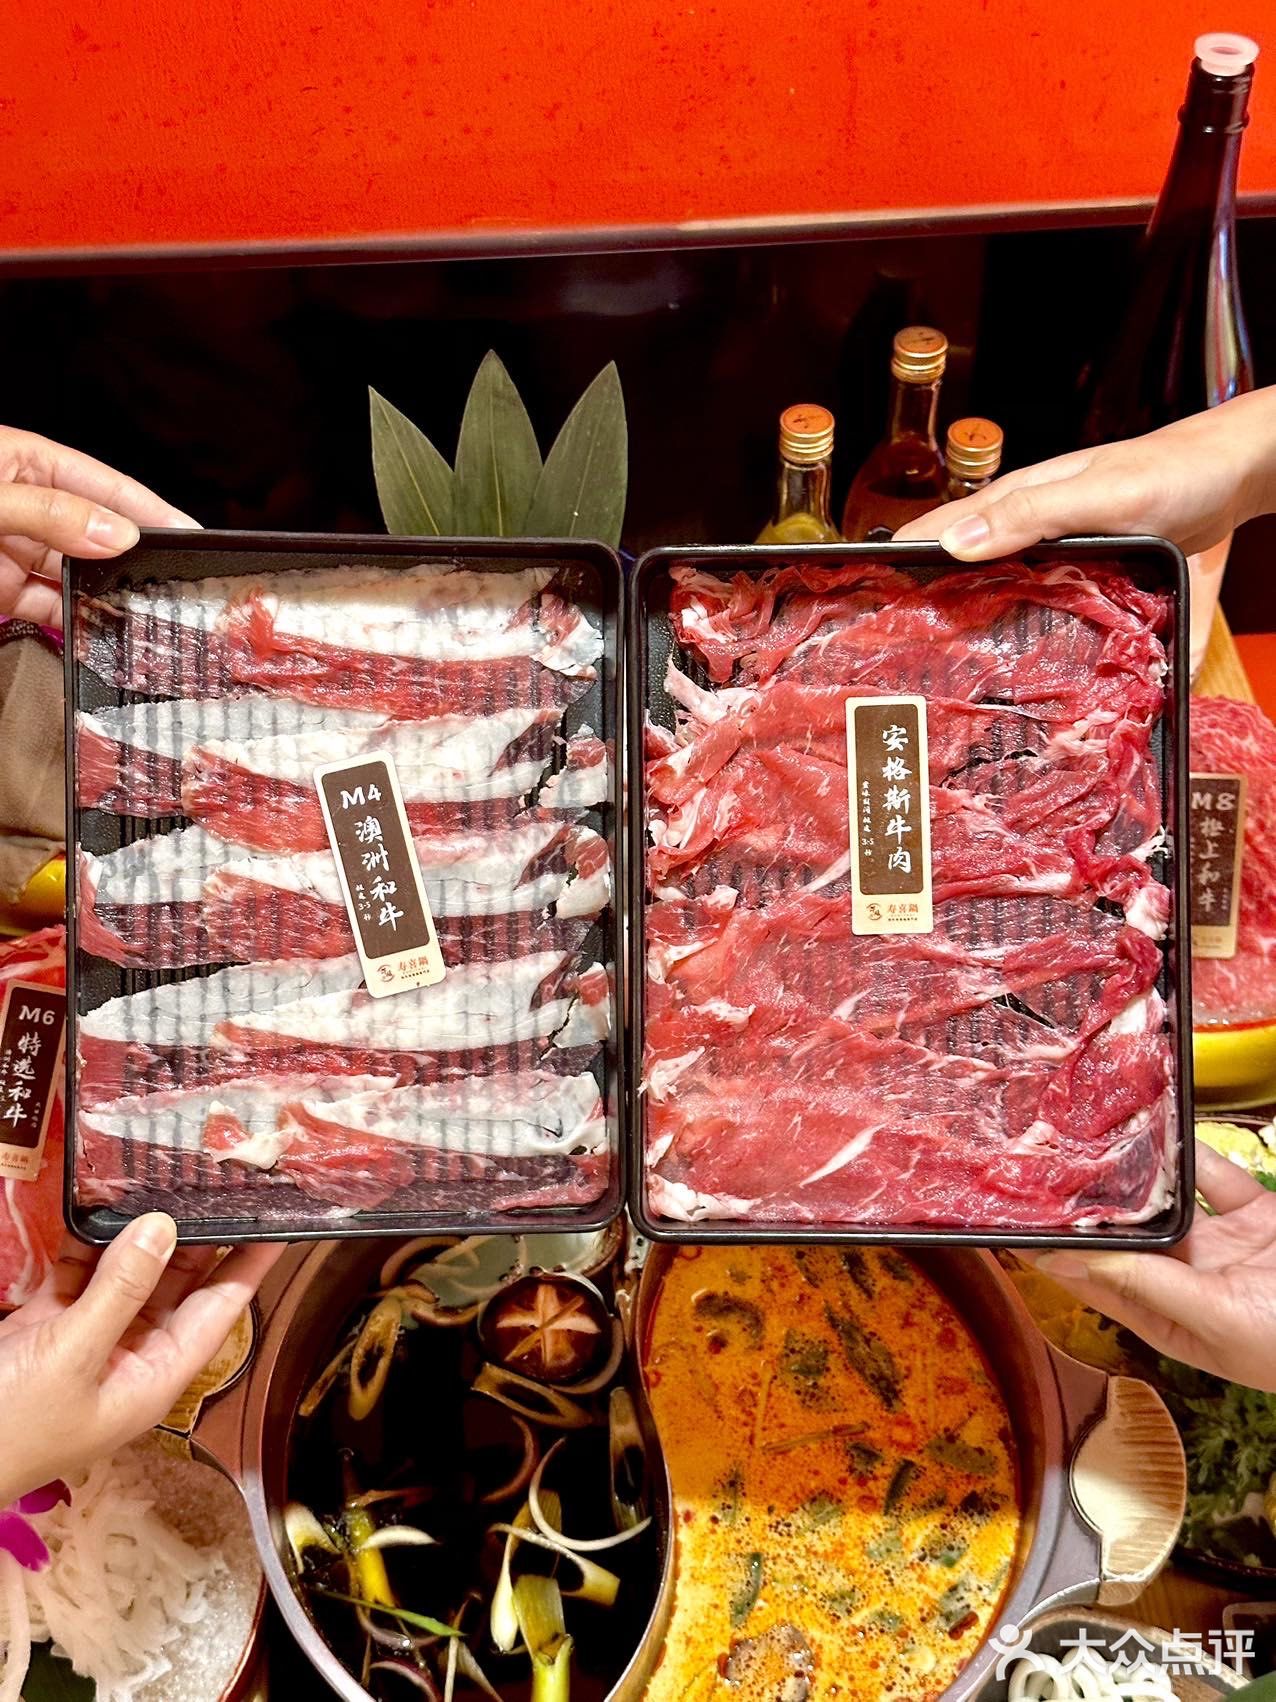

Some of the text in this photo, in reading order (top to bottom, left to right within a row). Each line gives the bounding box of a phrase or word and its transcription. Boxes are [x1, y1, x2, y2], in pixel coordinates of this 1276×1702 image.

[341, 784, 382, 810] M4
[881, 724, 913, 874] 安格斯牛肉
[1191, 792, 1236, 811] M8
[354, 816, 404, 931] 澳洲和牛
[18, 1005, 56, 1025] M6
